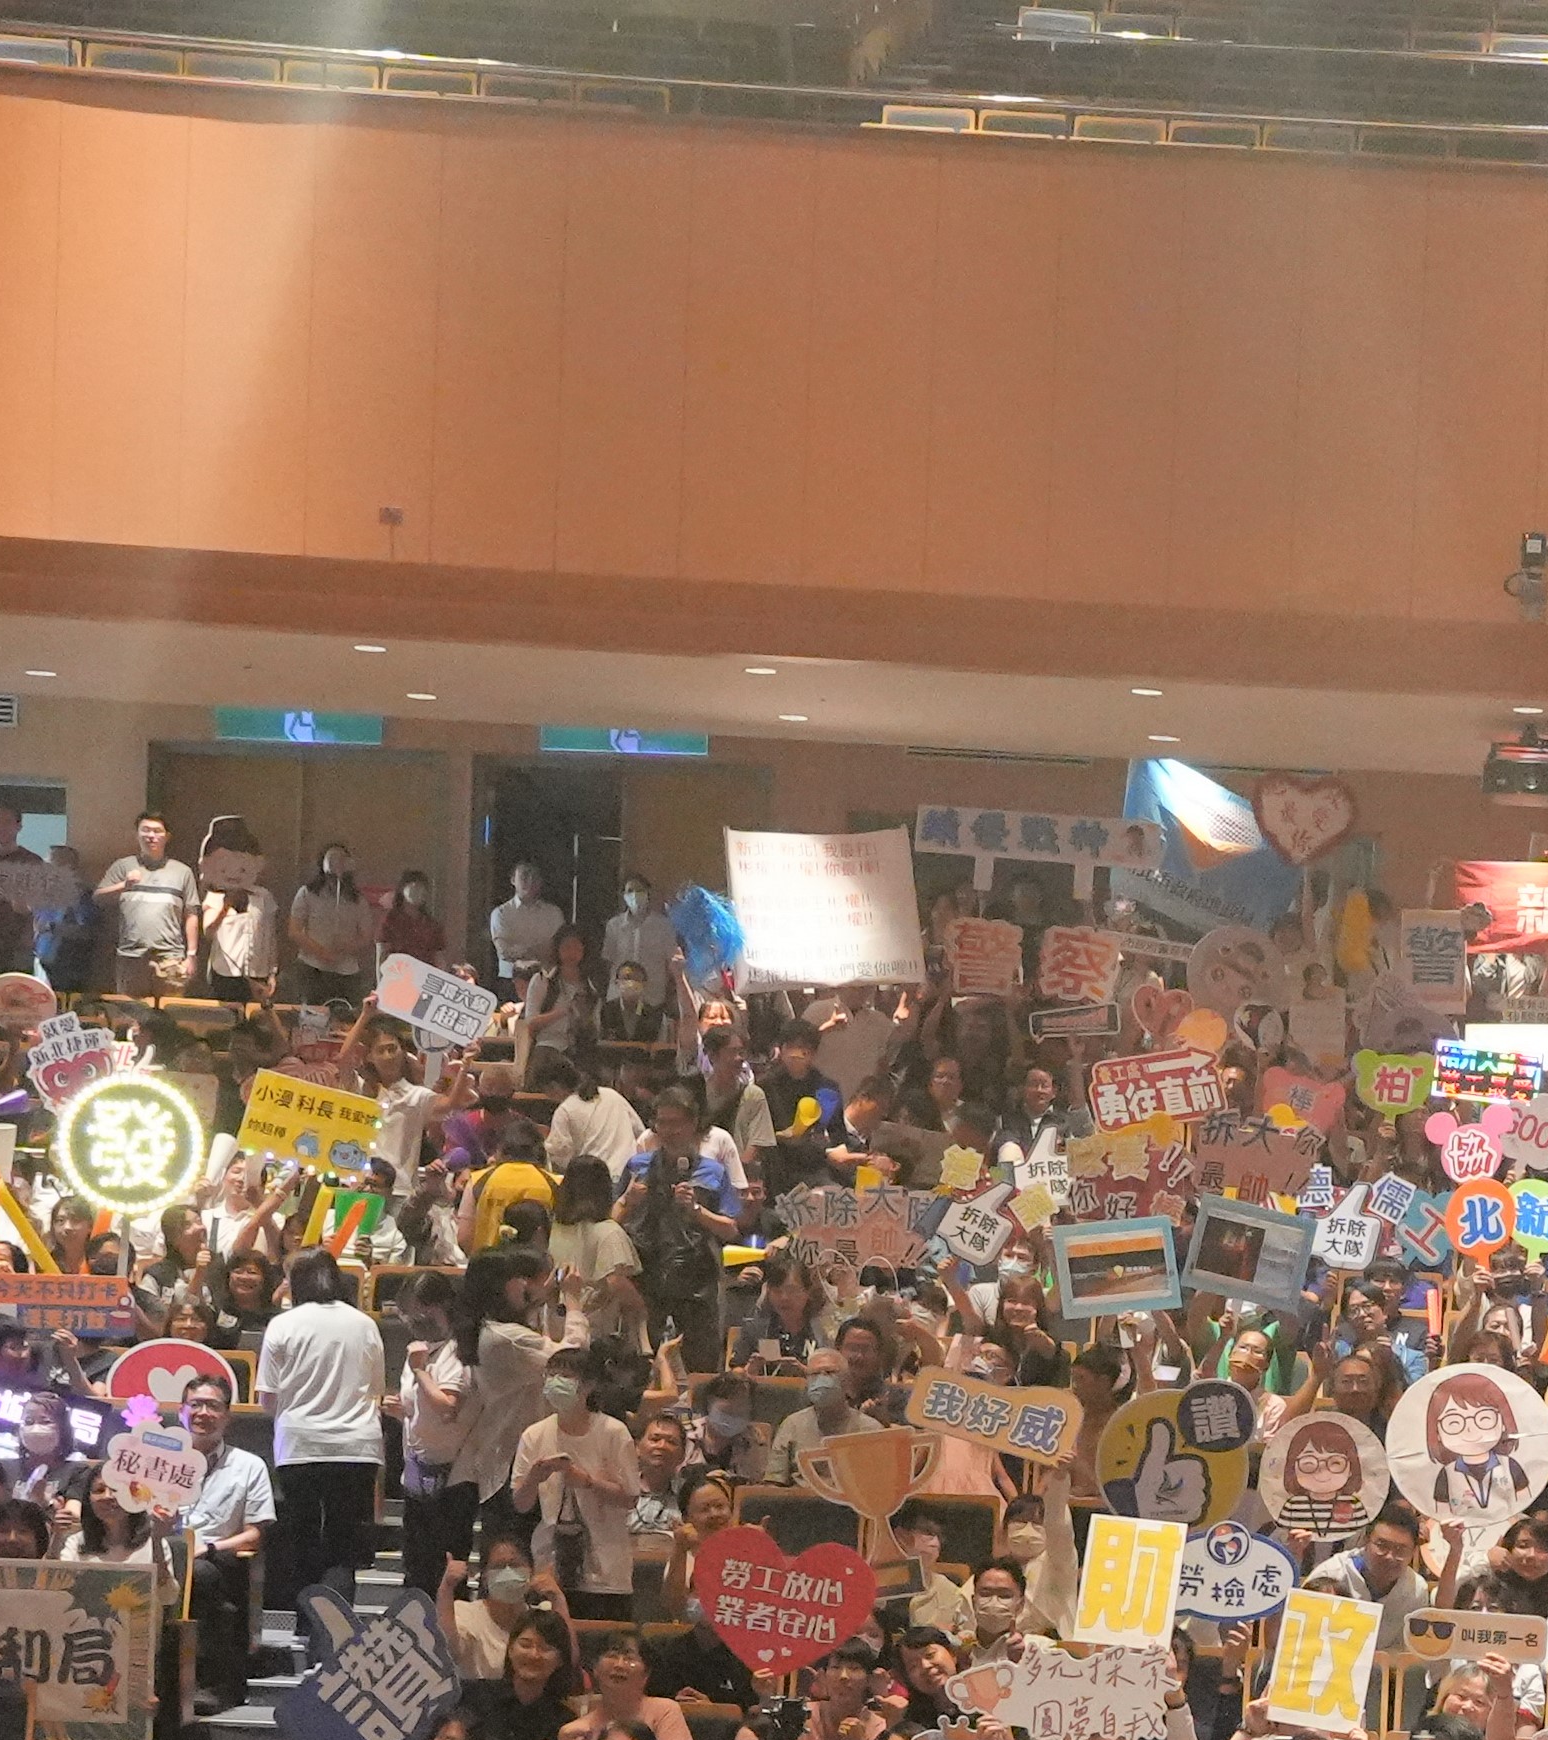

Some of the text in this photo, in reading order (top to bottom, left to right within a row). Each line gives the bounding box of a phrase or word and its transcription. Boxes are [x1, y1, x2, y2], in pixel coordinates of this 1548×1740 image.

[953, 918, 1113, 999] 警 察
[1406, 926, 1461, 986] 警
[33, 1031, 102, 1066] 新北捷運
[254, 1084, 336, 1121] 小漫科長
[1096, 1071, 1221, 1127] 勇往直前
[91, 1099, 175, 1188] 發
[1449, 1132, 1494, 1180] 協
[950, 1223, 991, 1253] 大隊
[959, 1204, 998, 1233] 拆除
[1326, 1217, 1366, 1238] 拆除
[1460, 1198, 1503, 1243] 北
[1324, 1236, 1364, 1257] 大隊
[922, 1379, 1067, 1456] 我好威
[1189, 1392, 1242, 1445] 讚
[114, 1448, 198, 1490] 秘書處
[720, 1557, 845, 1608] 勞工放心
[1079, 1516, 1183, 1634] 財
[1179, 1562, 1280, 1606] 勞檢處
[713, 1593, 837, 1644] 業者安心
[1460, 1625, 1538, 1648] 叫我第一名
[1023, 1644, 1178, 1691] 多元探索
[1270, 1597, 1380, 1719] 政
